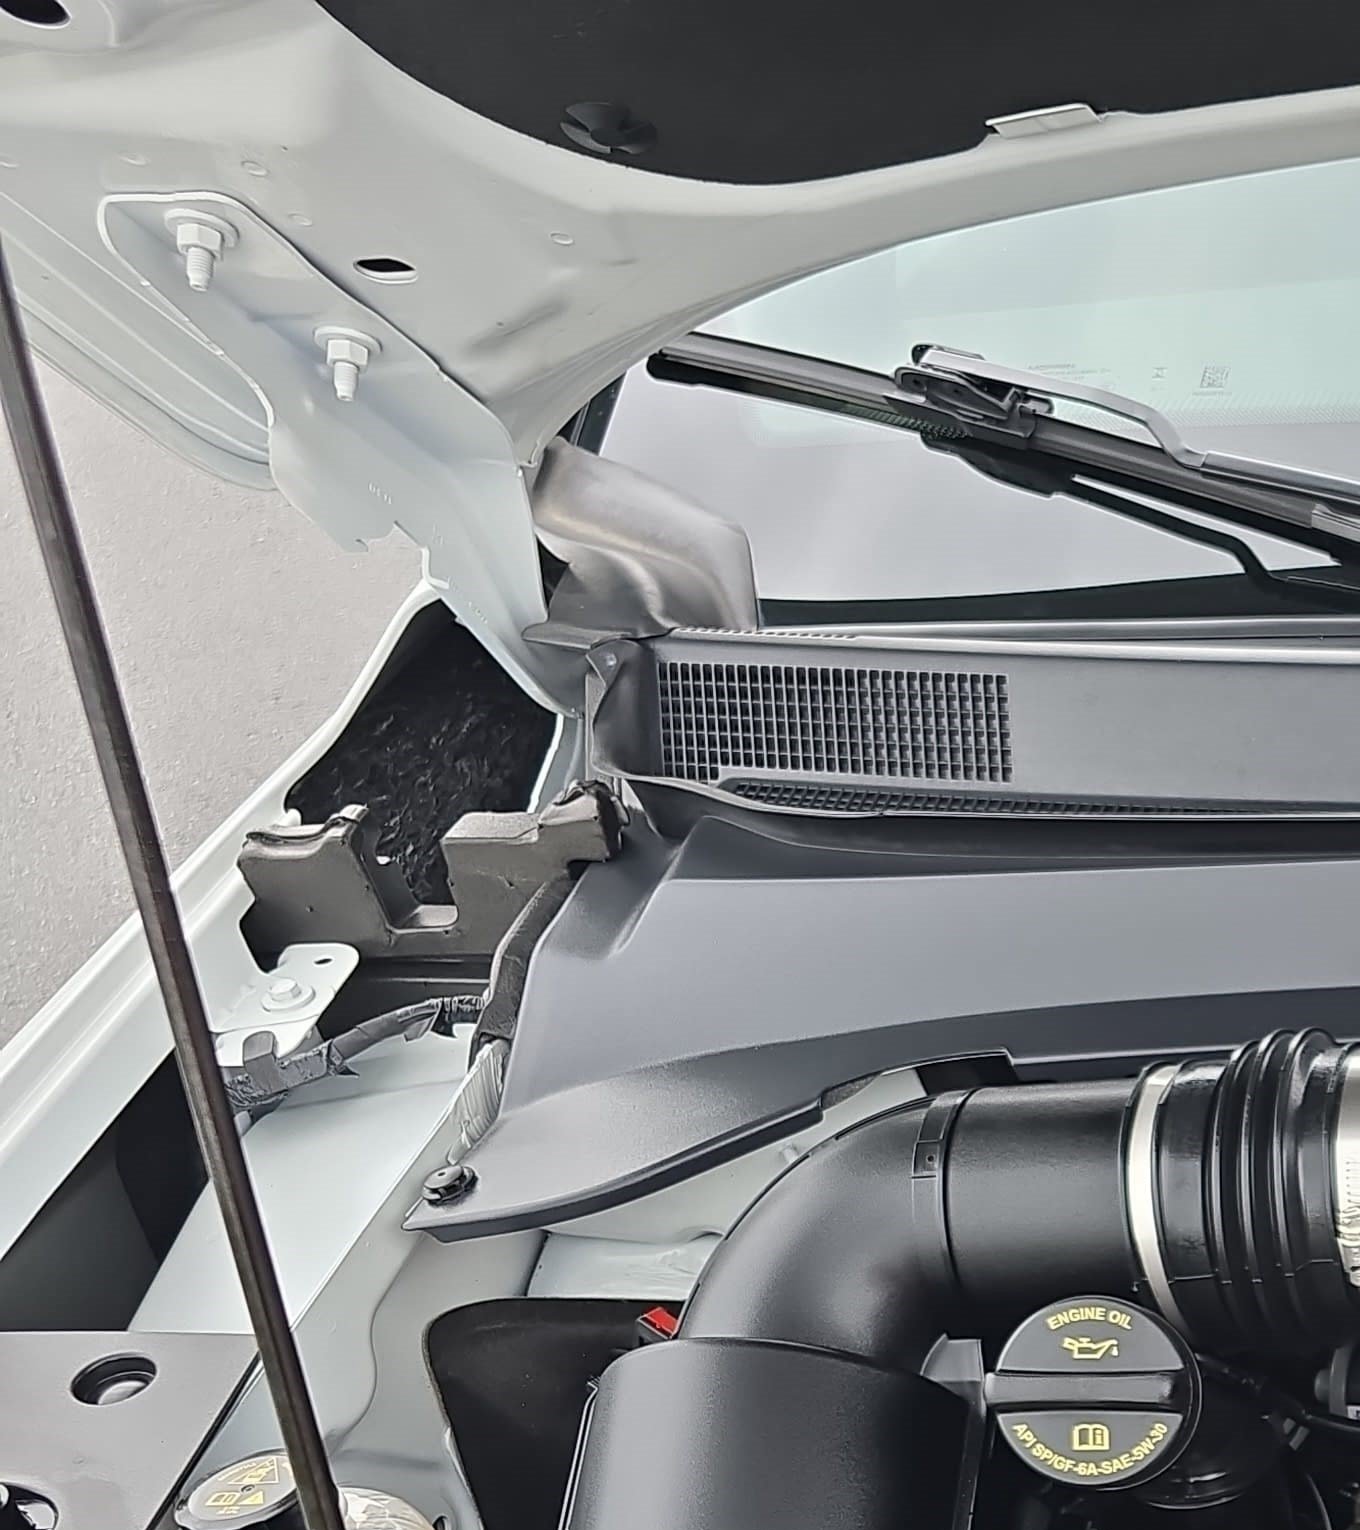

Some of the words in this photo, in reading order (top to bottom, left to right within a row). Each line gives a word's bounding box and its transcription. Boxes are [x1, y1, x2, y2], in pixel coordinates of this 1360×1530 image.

[1046, 1307, 1106, 1330] ENGINE
[1107, 1311, 1133, 1330] OIL
[1013, 1423, 1032, 1447] API
